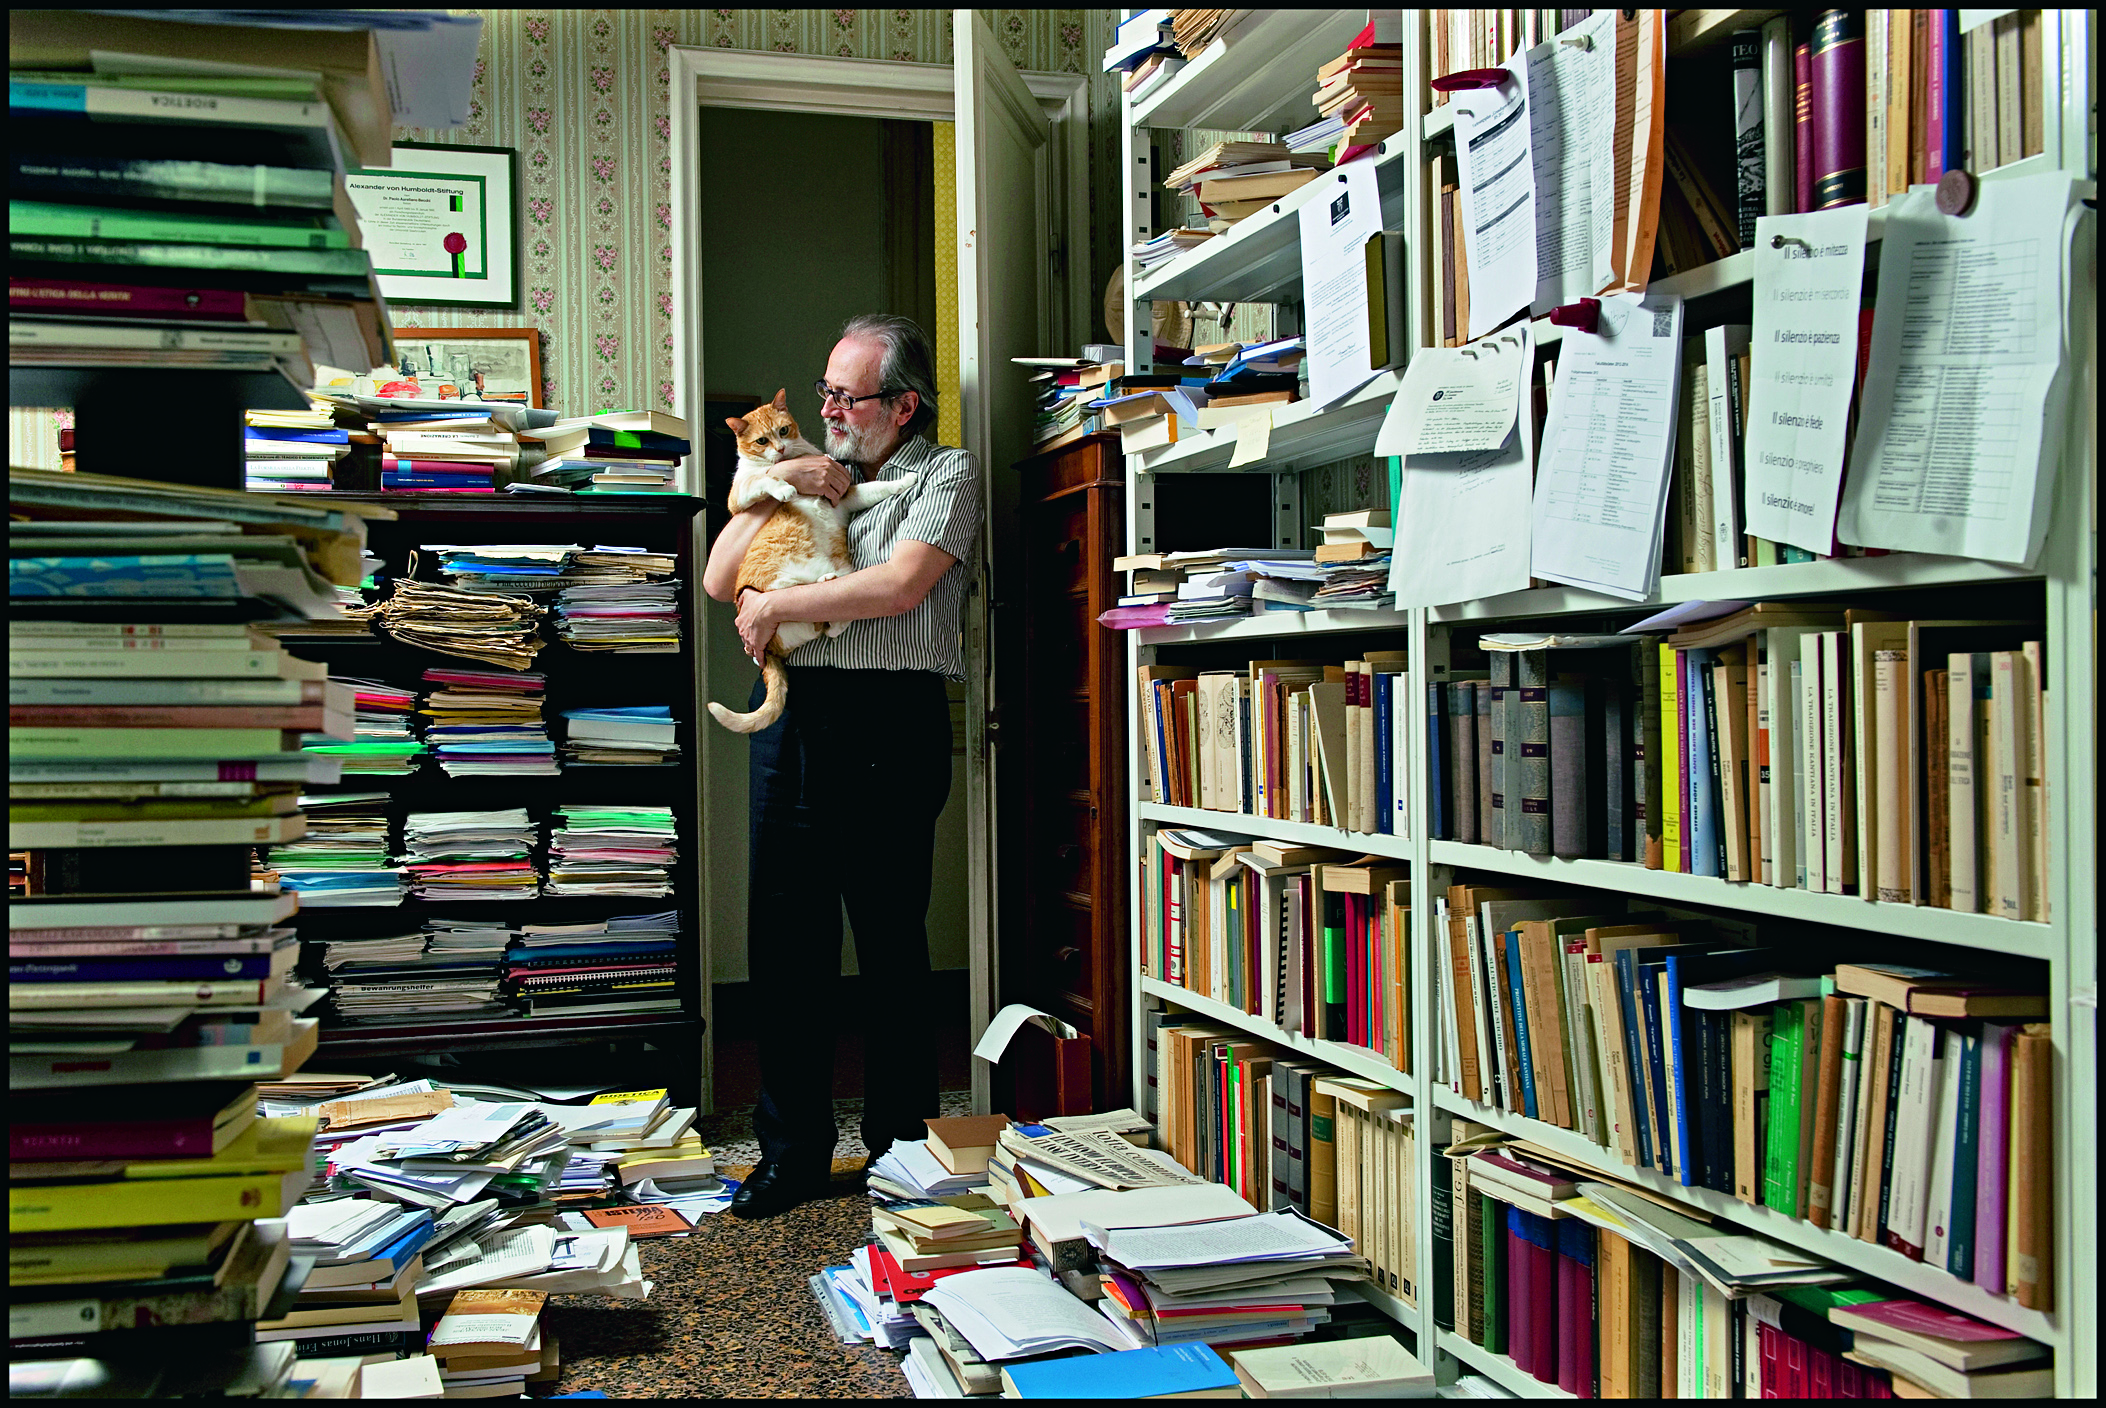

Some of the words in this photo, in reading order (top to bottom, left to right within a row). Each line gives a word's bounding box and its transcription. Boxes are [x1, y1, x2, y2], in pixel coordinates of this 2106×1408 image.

[152, 96, 217, 110] BIOETICA
[402, 186, 464, 195] Humboldt-Stiftung
[1784, 247, 1790, 259] Il
[1825, 244, 1848, 256] mitezza
[1773, 289, 1778, 301] Il
[1780, 289, 1807, 301] silenzio
[1774, 330, 1780, 343] Il
[1781, 330, 1807, 344] silenzio
[1808, 331, 1812, 343] è
[1813, 332, 1840, 346] pazienza
[1775, 371, 1779, 383] Il
[1780, 372, 1809, 384] silenzio
[1814, 374, 1833, 386] umiltà
[1772, 411, 1777, 424] Il
[1779, 413, 1804, 428] silenzio
[1810, 418, 1823, 430] fede
[1760, 451, 1764, 463] Il
[1765, 452, 1794, 468] silenzio
[1762, 492, 1765, 505] Il
[1766, 494, 1793, 510] silenzio
[1797, 500, 1814, 516] amore!
[1808, 686, 1813, 697] LA
[1828, 689, 1834, 699] LA
[1761, 770, 1770, 778] 35
[1810, 798, 1816, 807] IN
[1830, 801, 1835, 811] IN
[1489, 957, 1498, 997] SULL'ETICA
[1494, 1017, 1503, 1051] SUICIDIO
[1514, 988, 1523, 1021] PROSPETTIVE
[1522, 1062, 1530, 1089] KANTIANA
[599, 1090, 659, 1099] BIOETICA
[1092, 1130, 1128, 1152] lotta
[321, 1337, 352, 1347] Jonas
[354, 1334, 380, 1343] Hans
